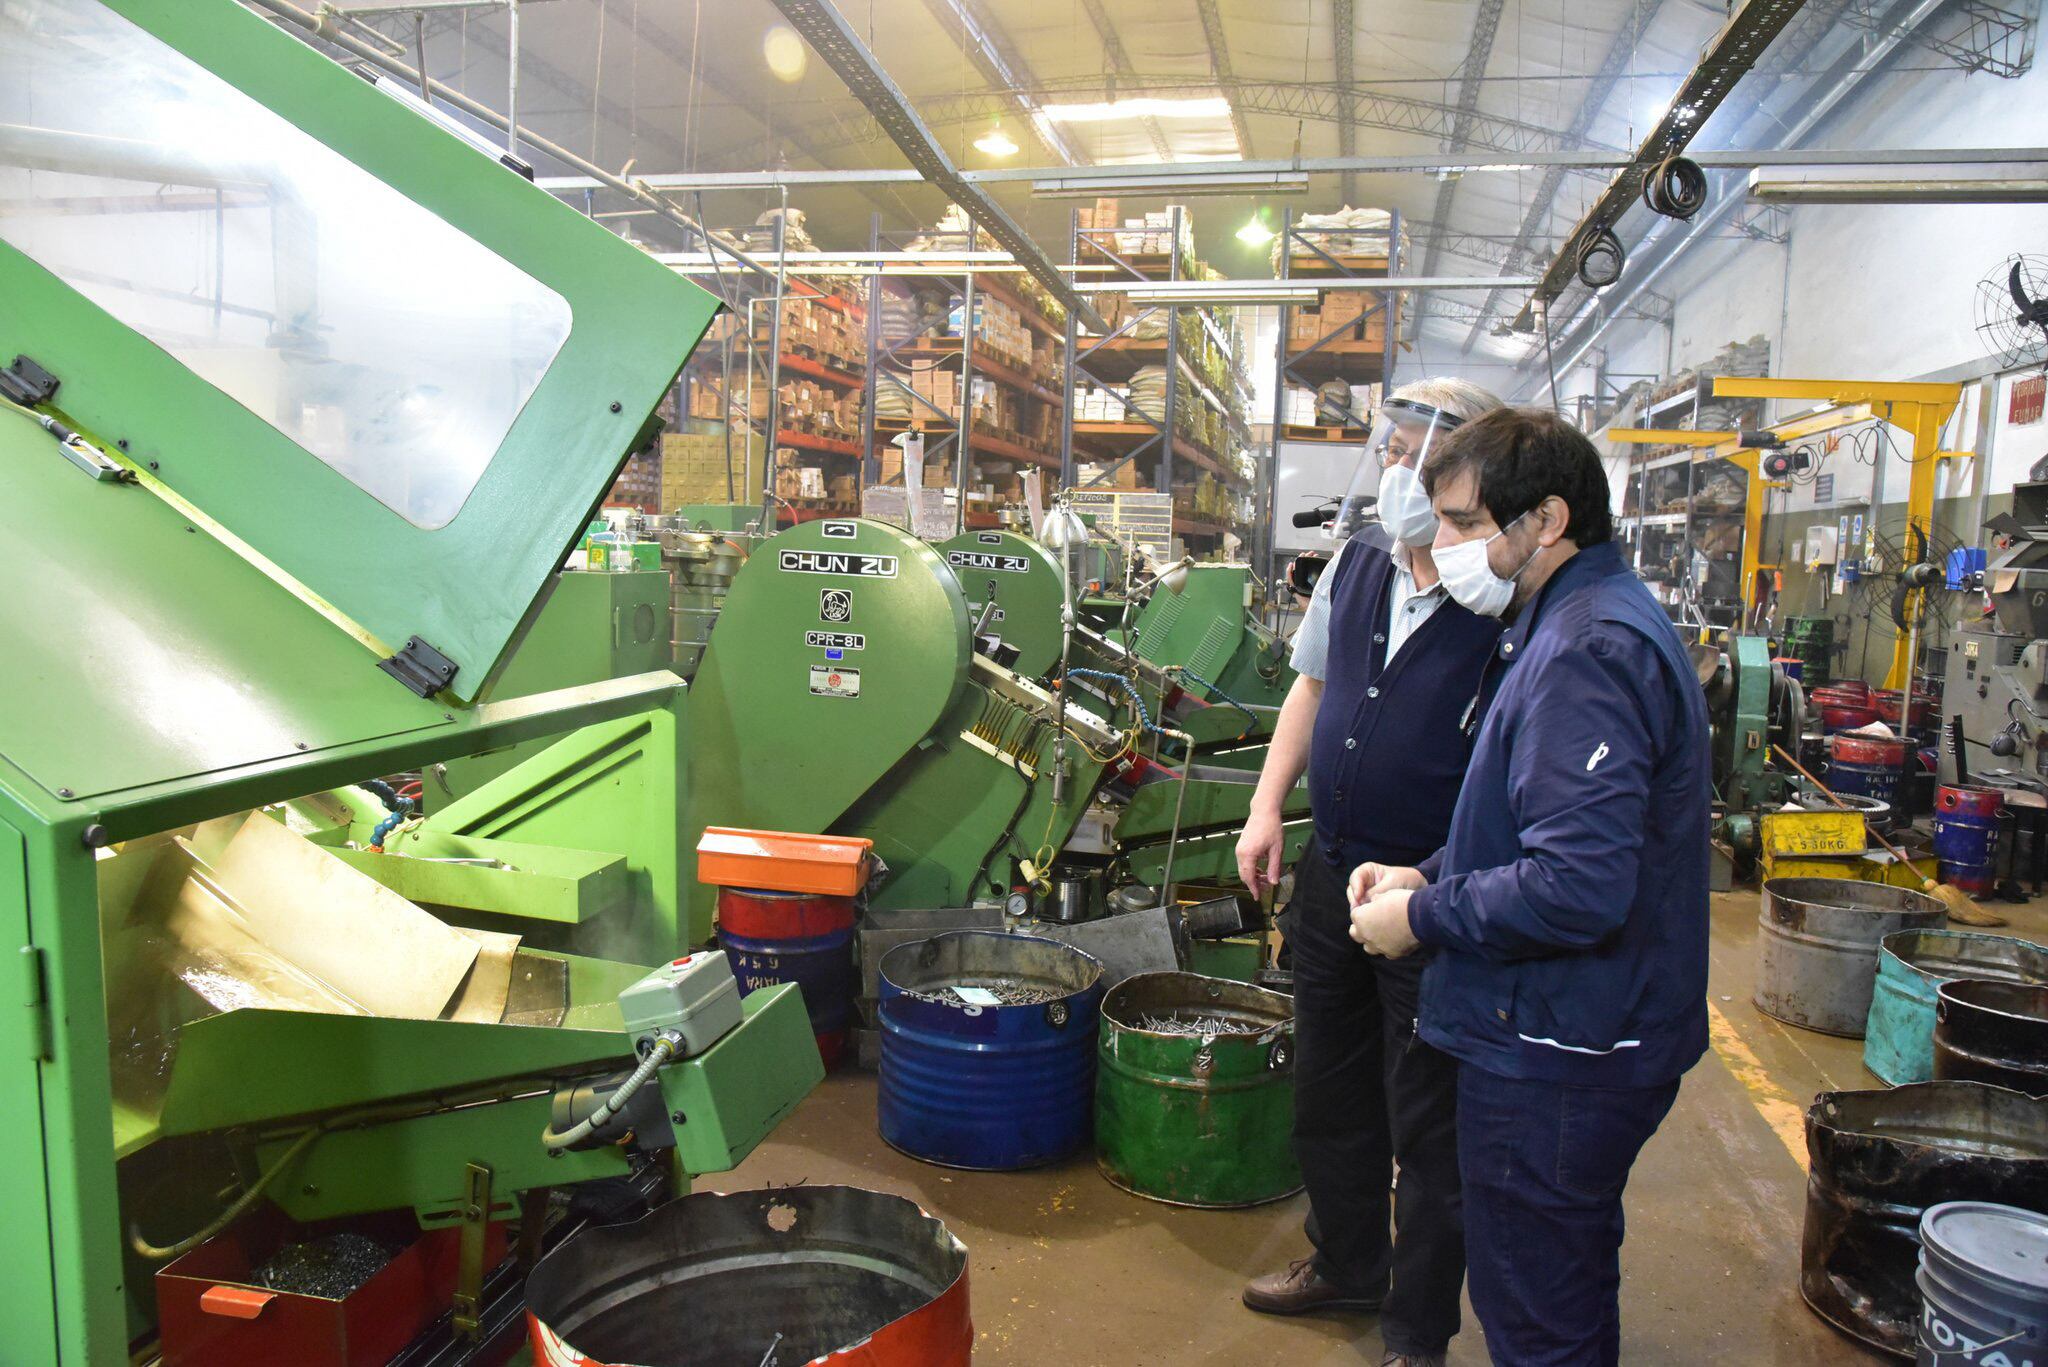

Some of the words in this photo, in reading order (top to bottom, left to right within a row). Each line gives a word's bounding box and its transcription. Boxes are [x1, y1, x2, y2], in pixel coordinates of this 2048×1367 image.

[781, 552, 849, 573] CHUN
[860, 557, 896, 576] ZU
[949, 553, 996, 568] CHUN
[1003, 557, 1028, 571] ZU
[807, 633, 863, 649] CPR-8L
